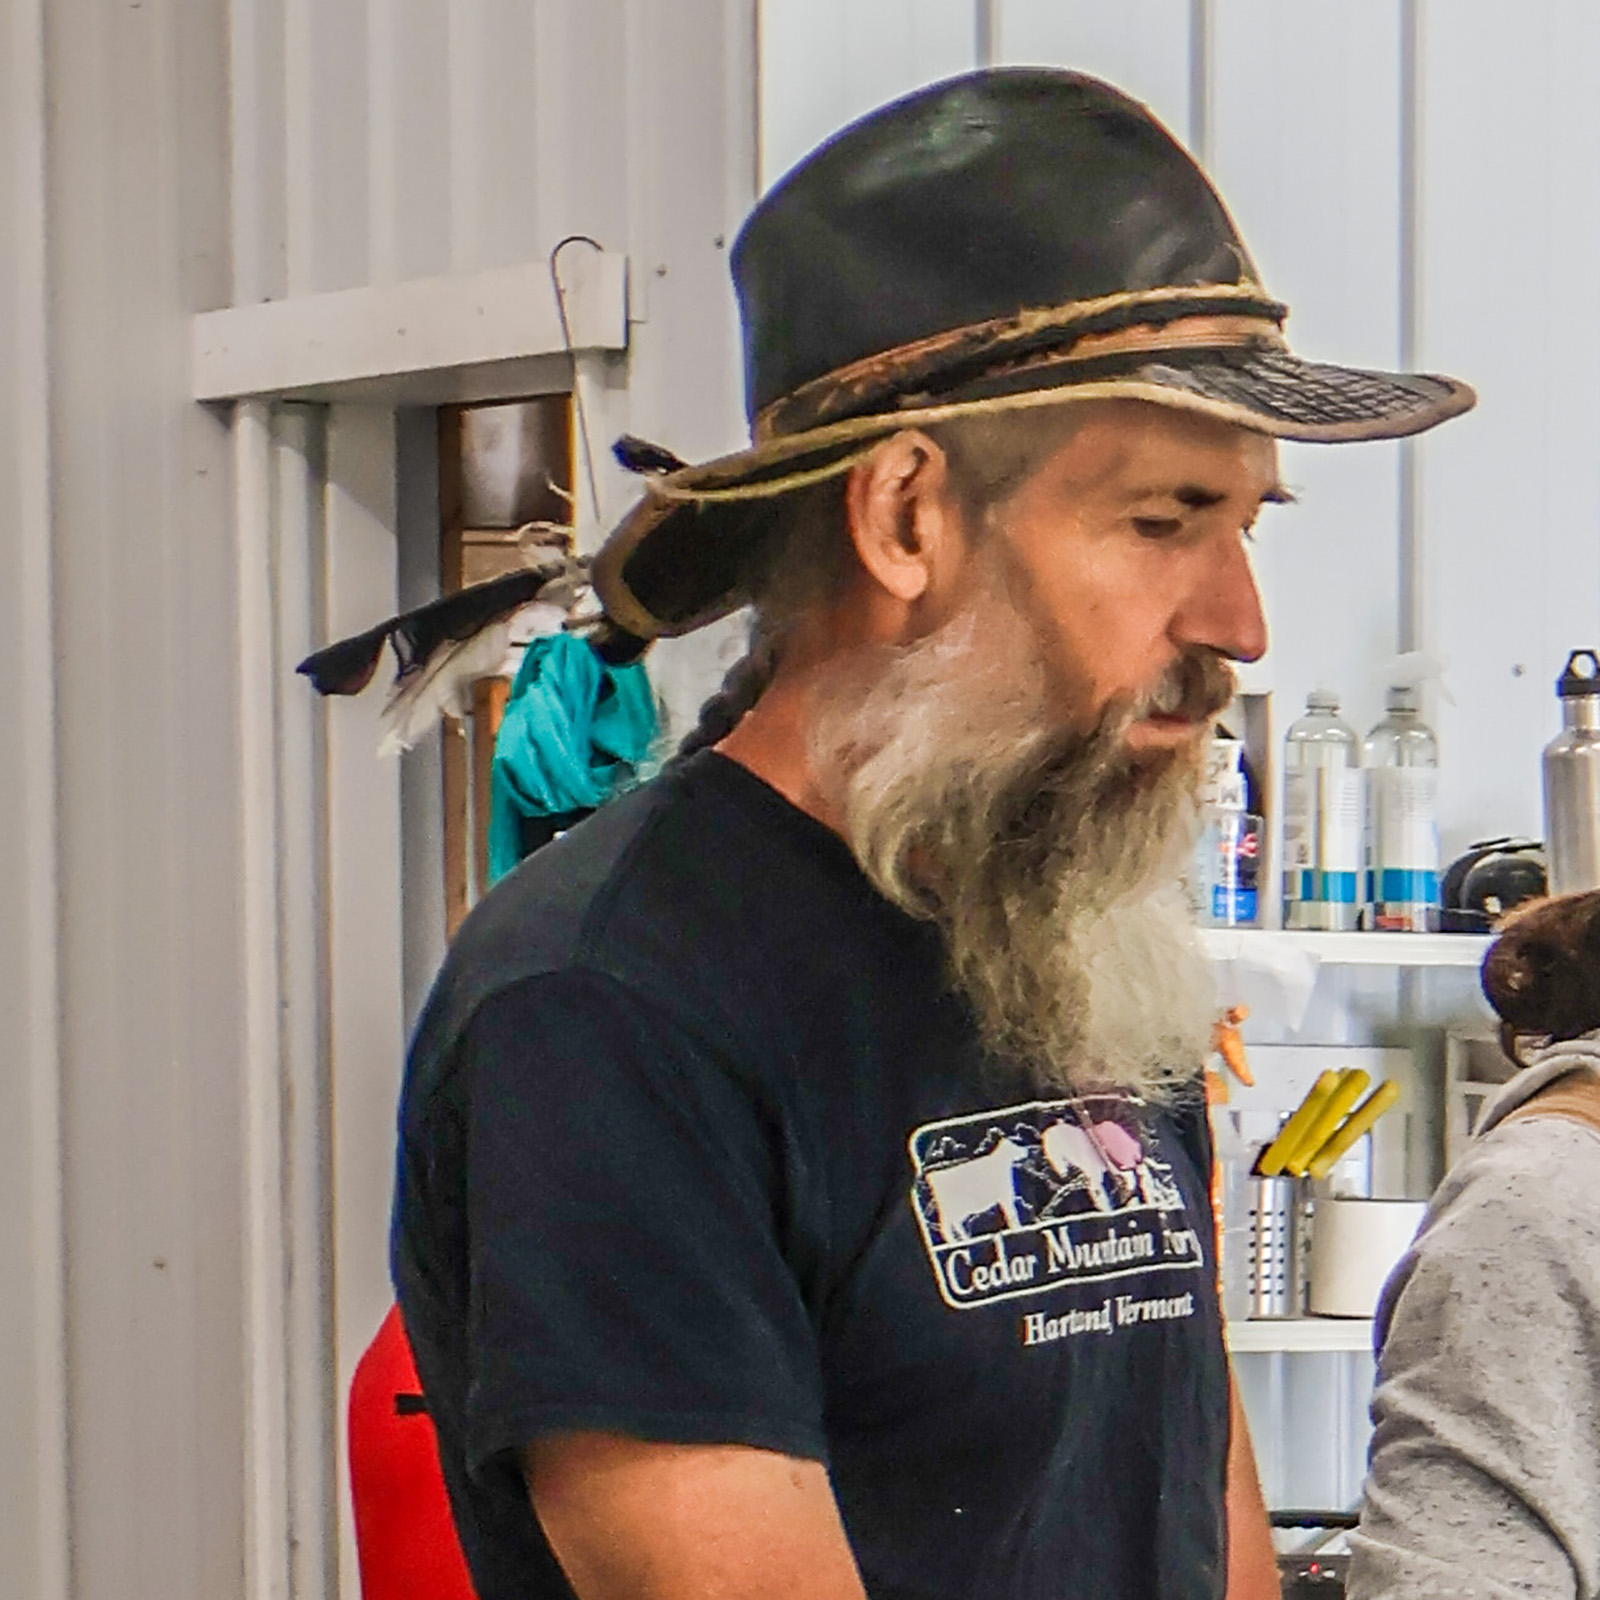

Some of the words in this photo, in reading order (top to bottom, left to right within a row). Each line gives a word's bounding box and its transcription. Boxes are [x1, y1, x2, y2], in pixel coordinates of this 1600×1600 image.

[946, 1232, 1037, 1296] Cedar
[1042, 1220, 1155, 1274] Mountain
[1115, 1291, 1196, 1326] Vermont
